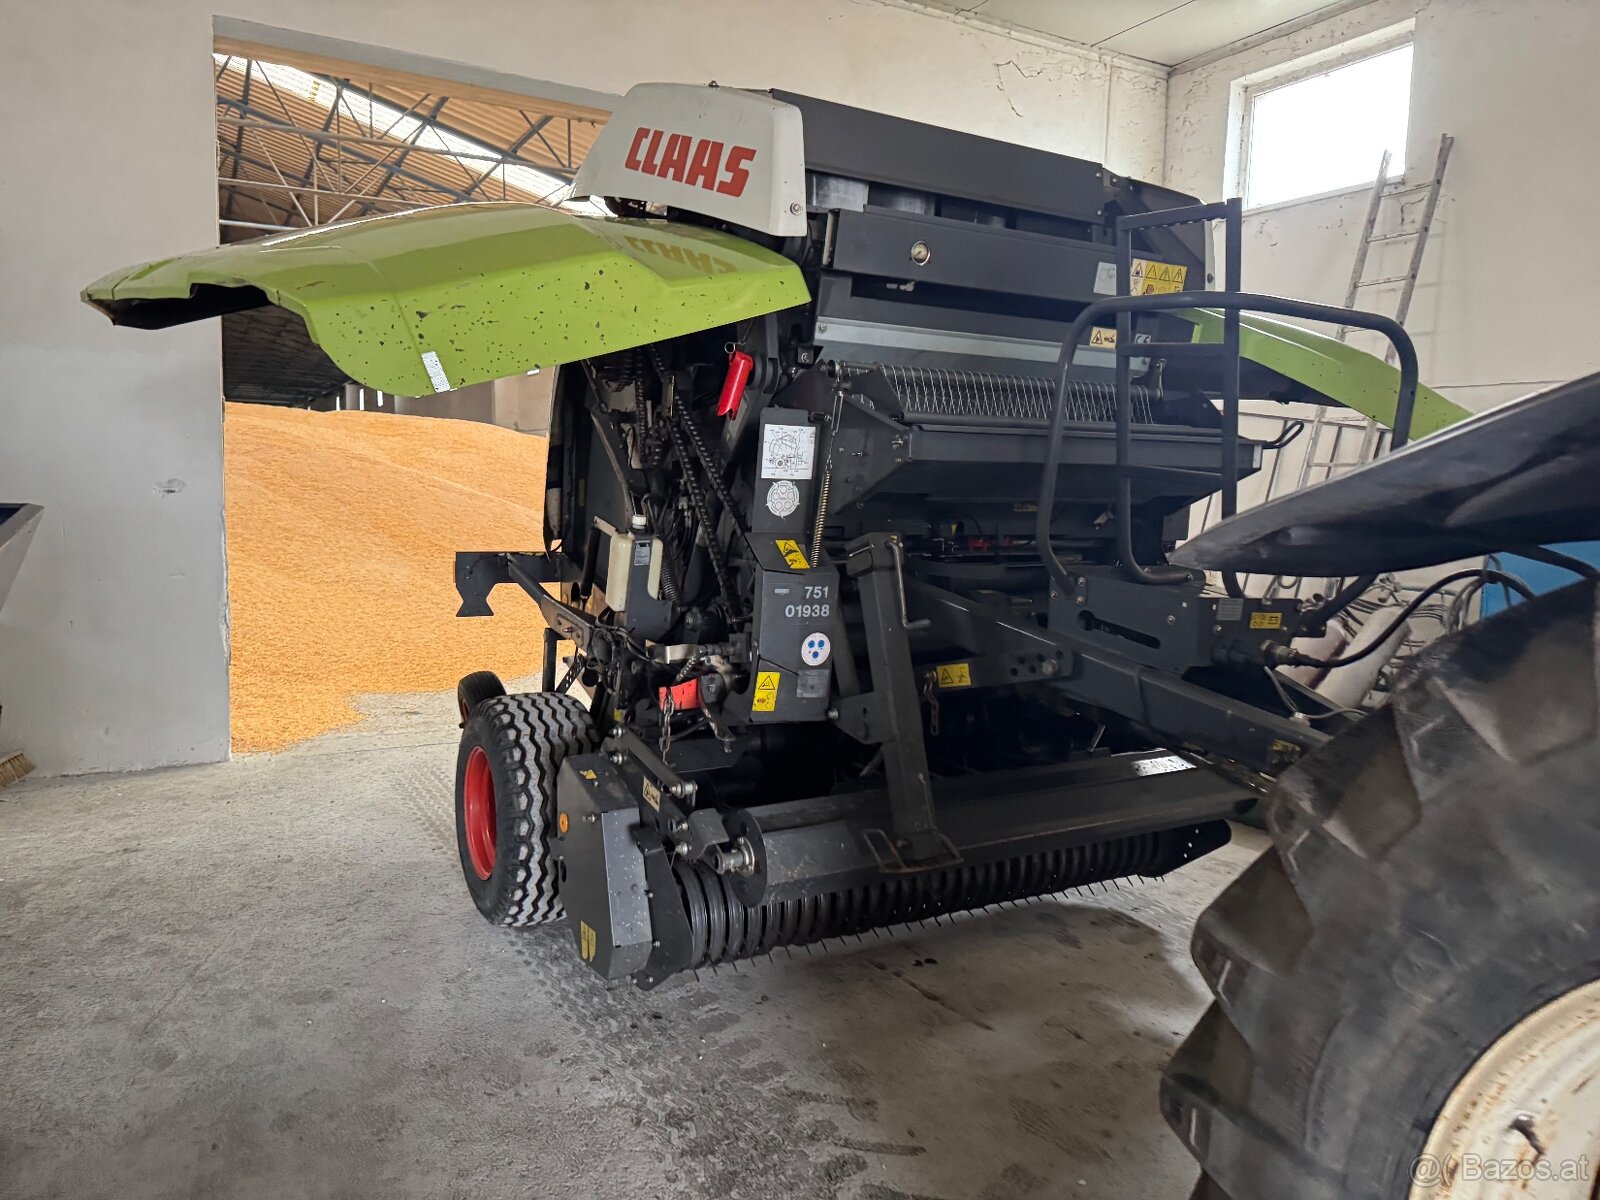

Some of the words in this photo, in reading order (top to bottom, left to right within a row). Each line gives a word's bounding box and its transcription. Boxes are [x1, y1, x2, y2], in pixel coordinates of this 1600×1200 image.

[625, 127, 757, 197] CLAAS
[804, 586, 829, 599] 751
[785, 604, 830, 618] 01938
